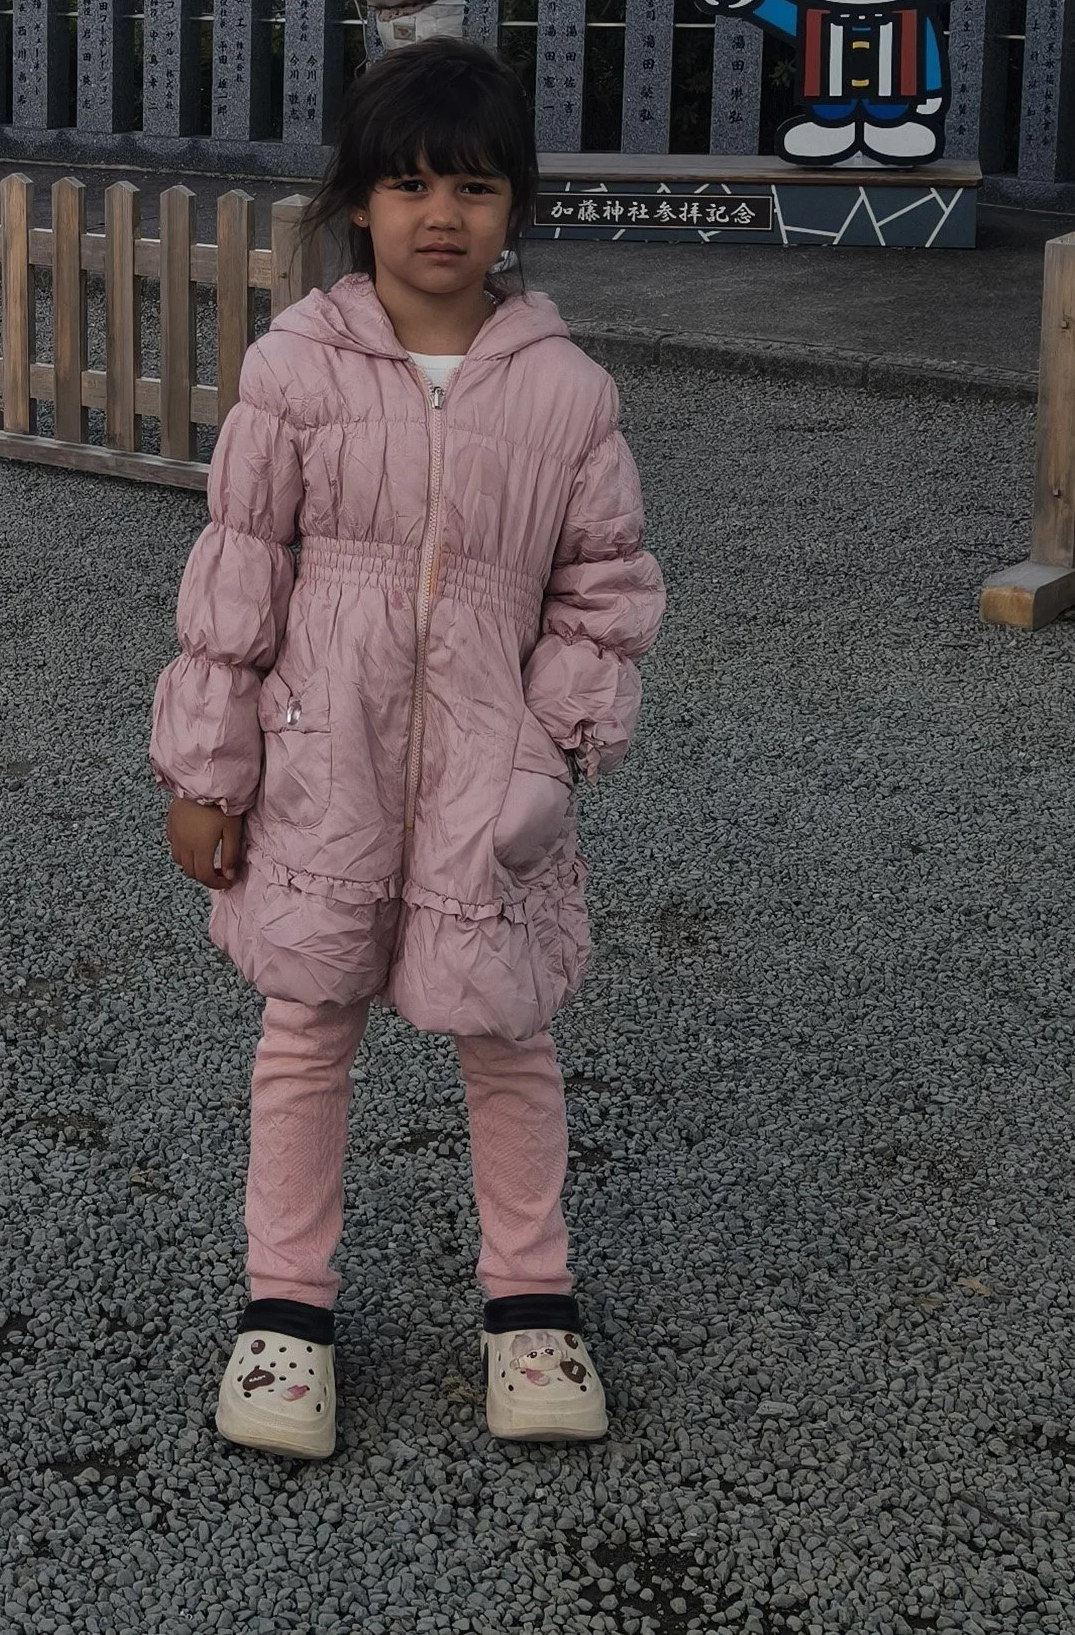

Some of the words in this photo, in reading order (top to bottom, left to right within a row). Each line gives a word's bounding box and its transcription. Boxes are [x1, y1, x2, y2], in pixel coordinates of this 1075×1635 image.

[550, 199, 756, 225] 加藤神社参拝記念
